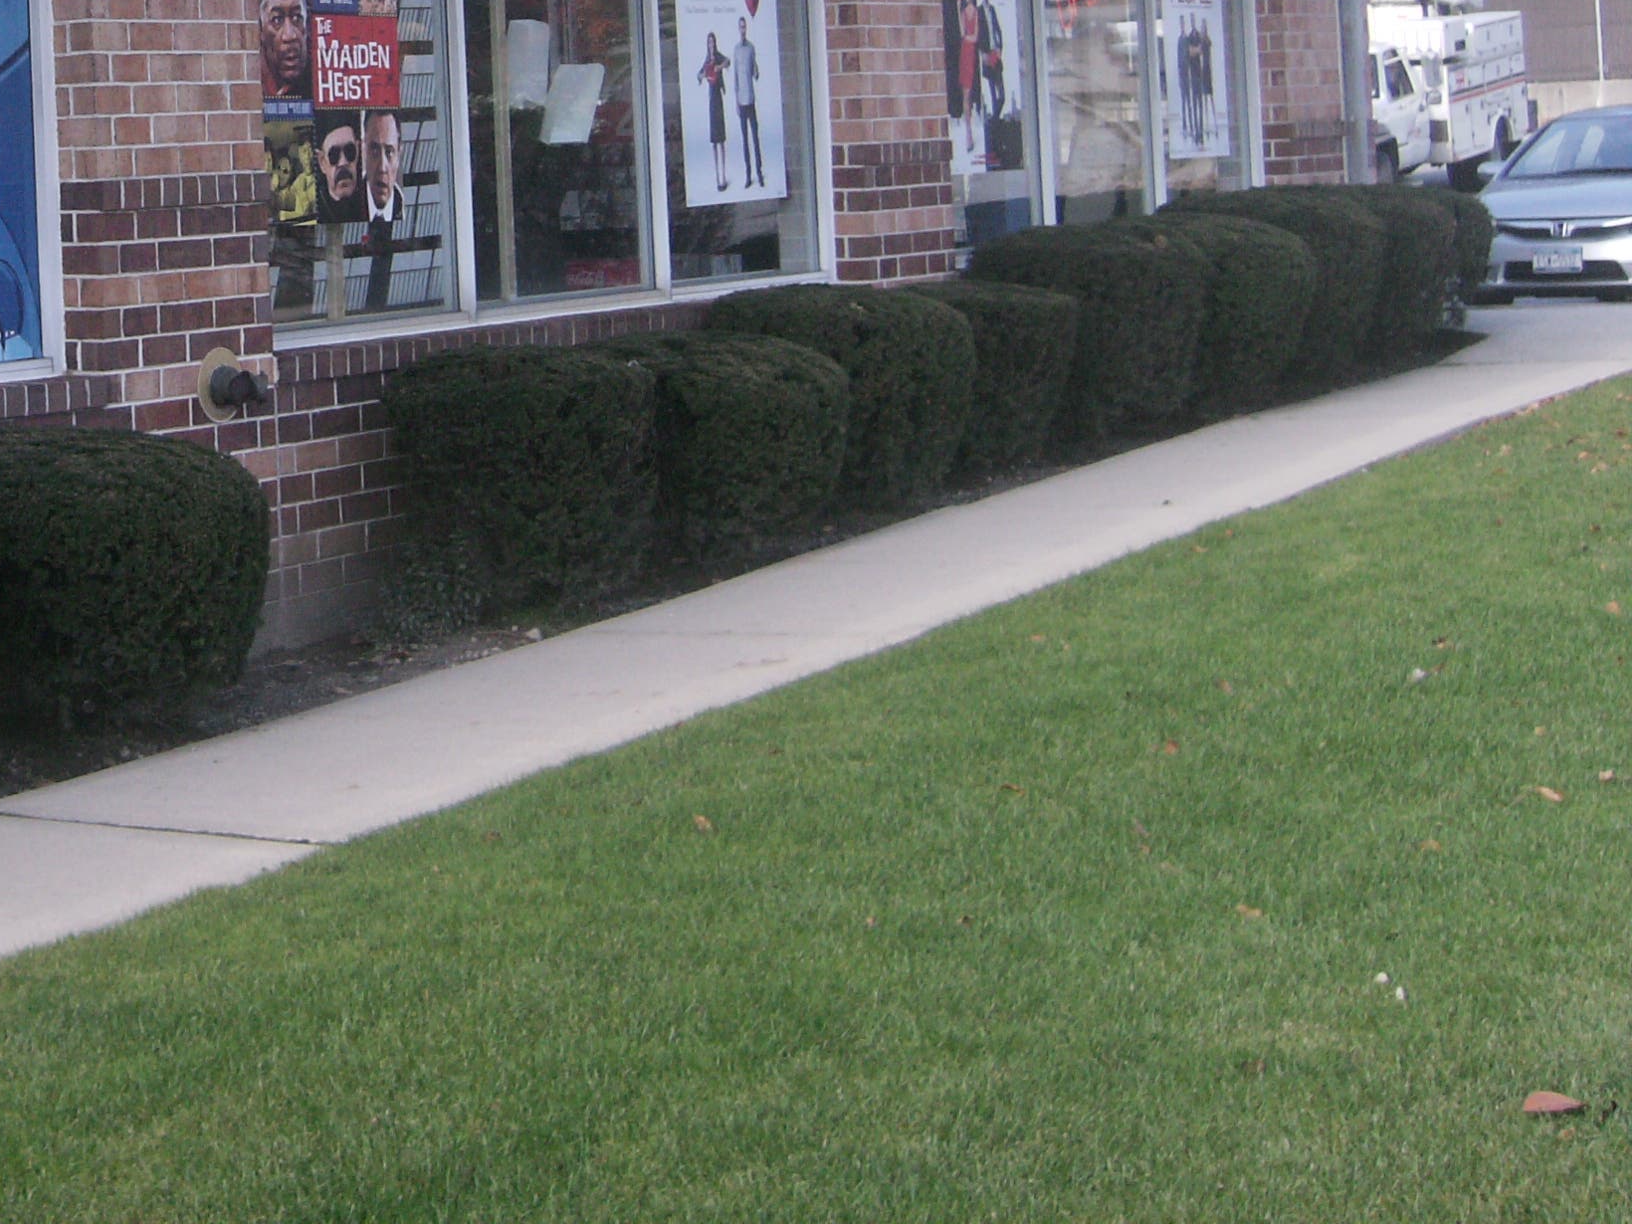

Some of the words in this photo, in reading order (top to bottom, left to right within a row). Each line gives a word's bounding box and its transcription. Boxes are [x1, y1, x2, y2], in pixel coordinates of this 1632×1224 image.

[315, 17, 332, 34] THE
[317, 36, 390, 69] MAIDEN
[319, 70, 372, 103] HEIST
